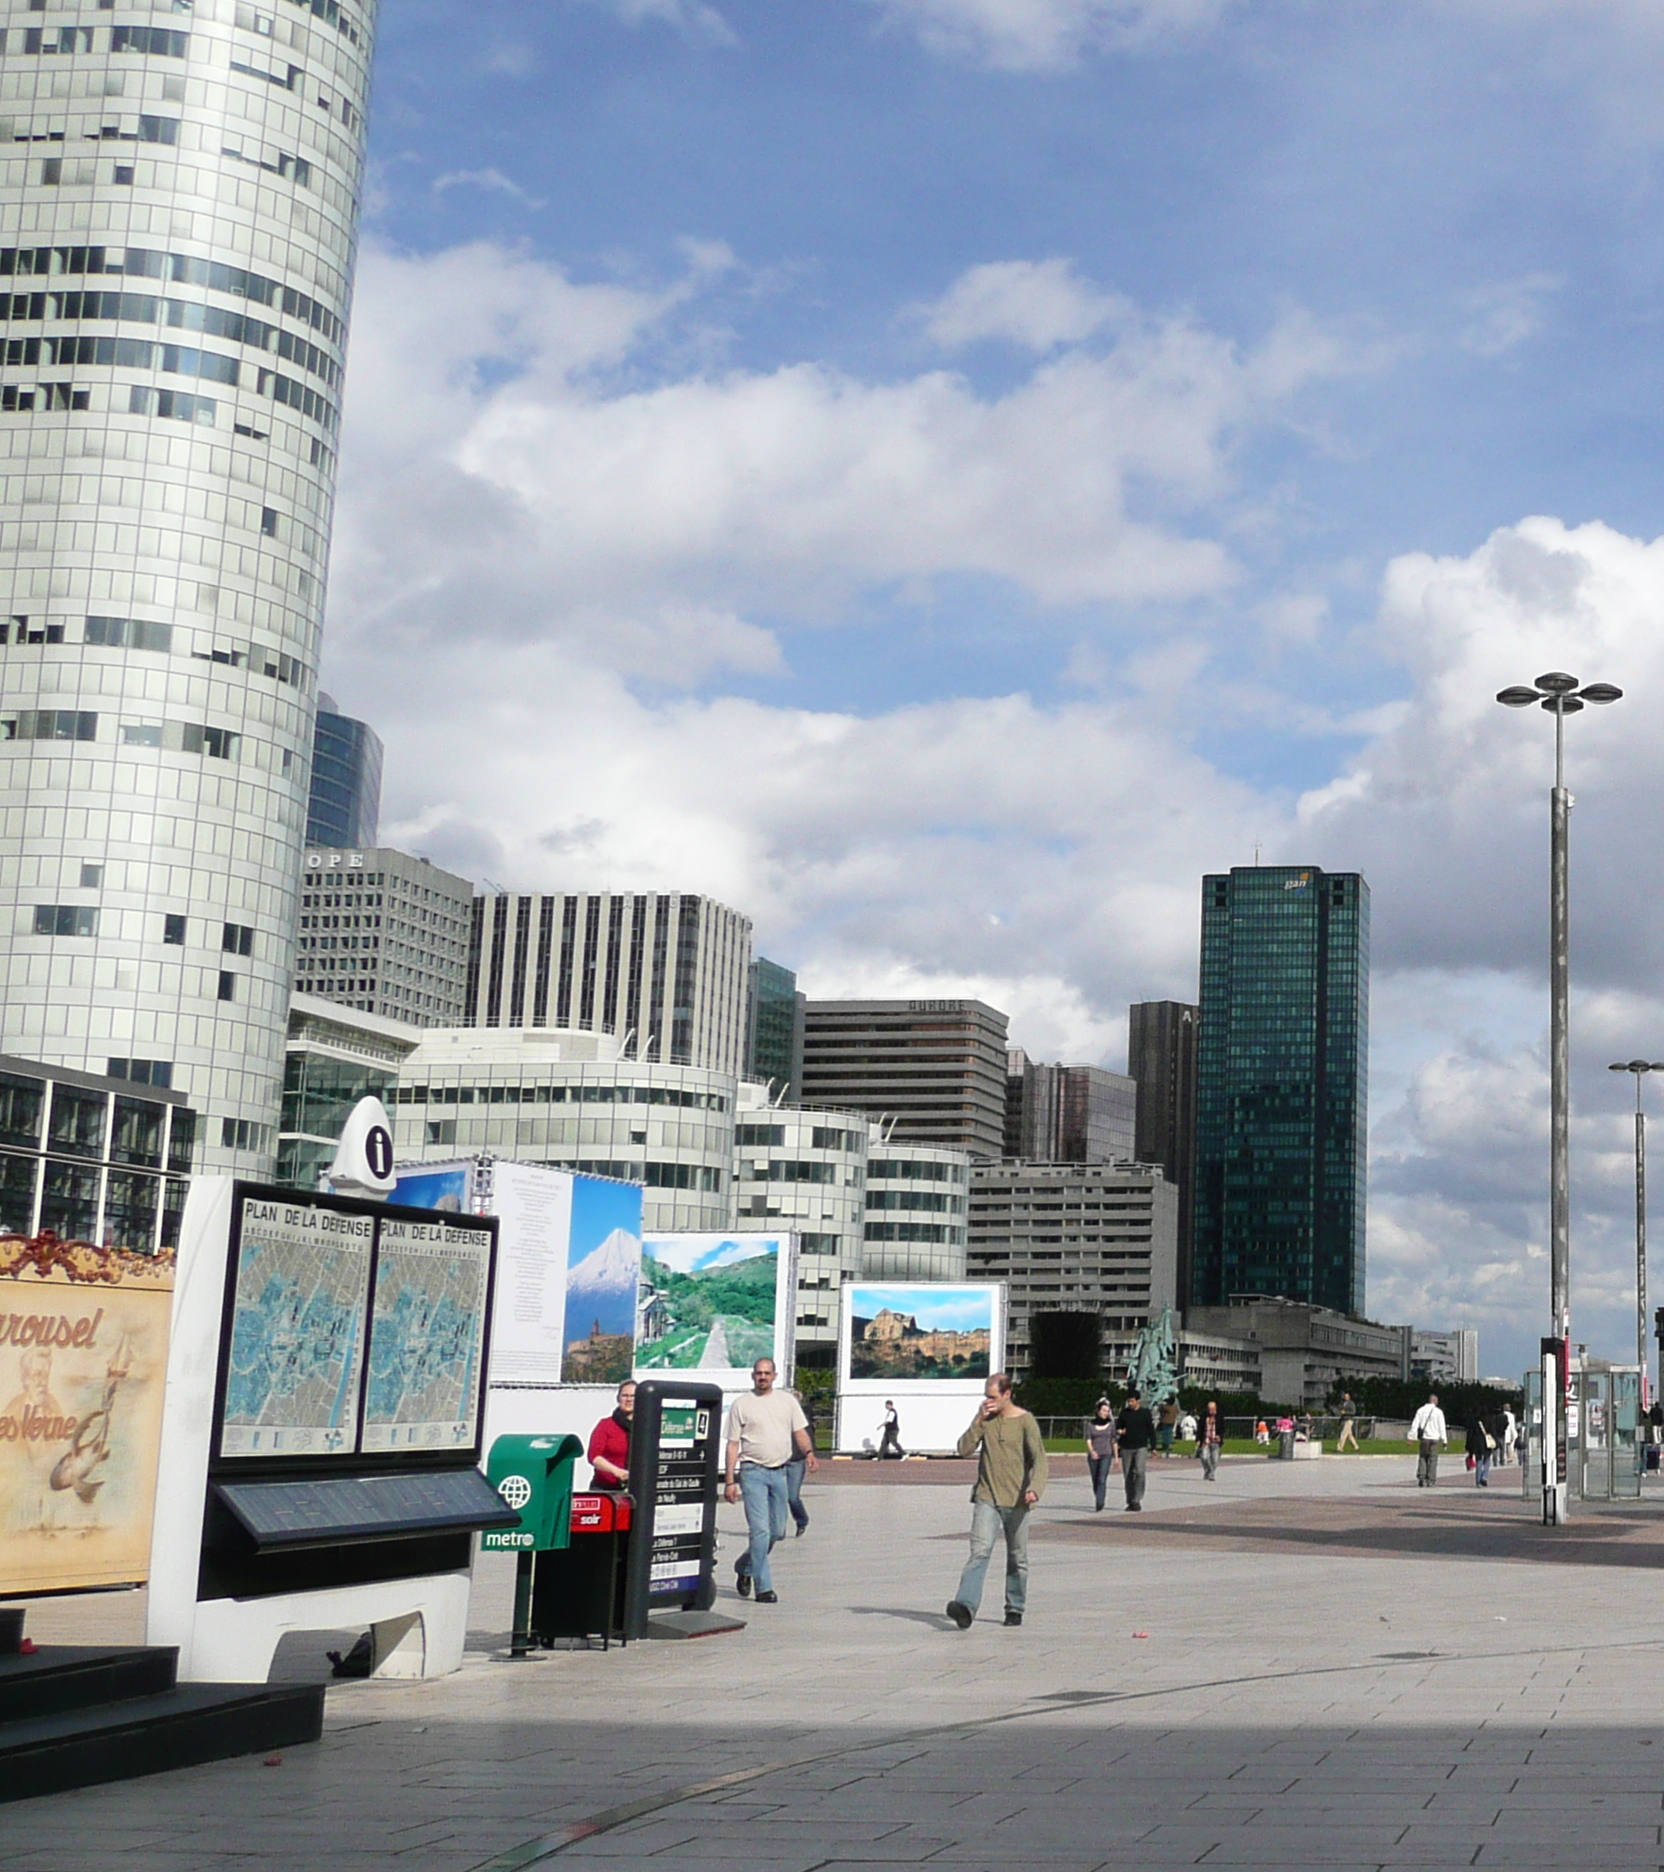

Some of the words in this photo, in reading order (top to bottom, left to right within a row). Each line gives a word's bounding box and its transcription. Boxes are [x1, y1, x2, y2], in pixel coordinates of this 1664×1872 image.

[1284, 880, 1307, 890] gan
[245, 1201, 278, 1222] PLAN
[284, 1208, 300, 1226] DE
[302, 1211, 317, 1229] LA
[321, 1215, 372, 1237] DEFENSE
[380, 1222, 406, 1239] PLAN
[412, 1224, 427, 1240] DE
[429, 1225, 442, 1242] LA
[444, 1228, 488, 1246] DEFENSE
[22, 1404, 77, 1441] Verne
[580, 1514, 601, 1524] soir
[486, 1532, 534, 1546] metro
